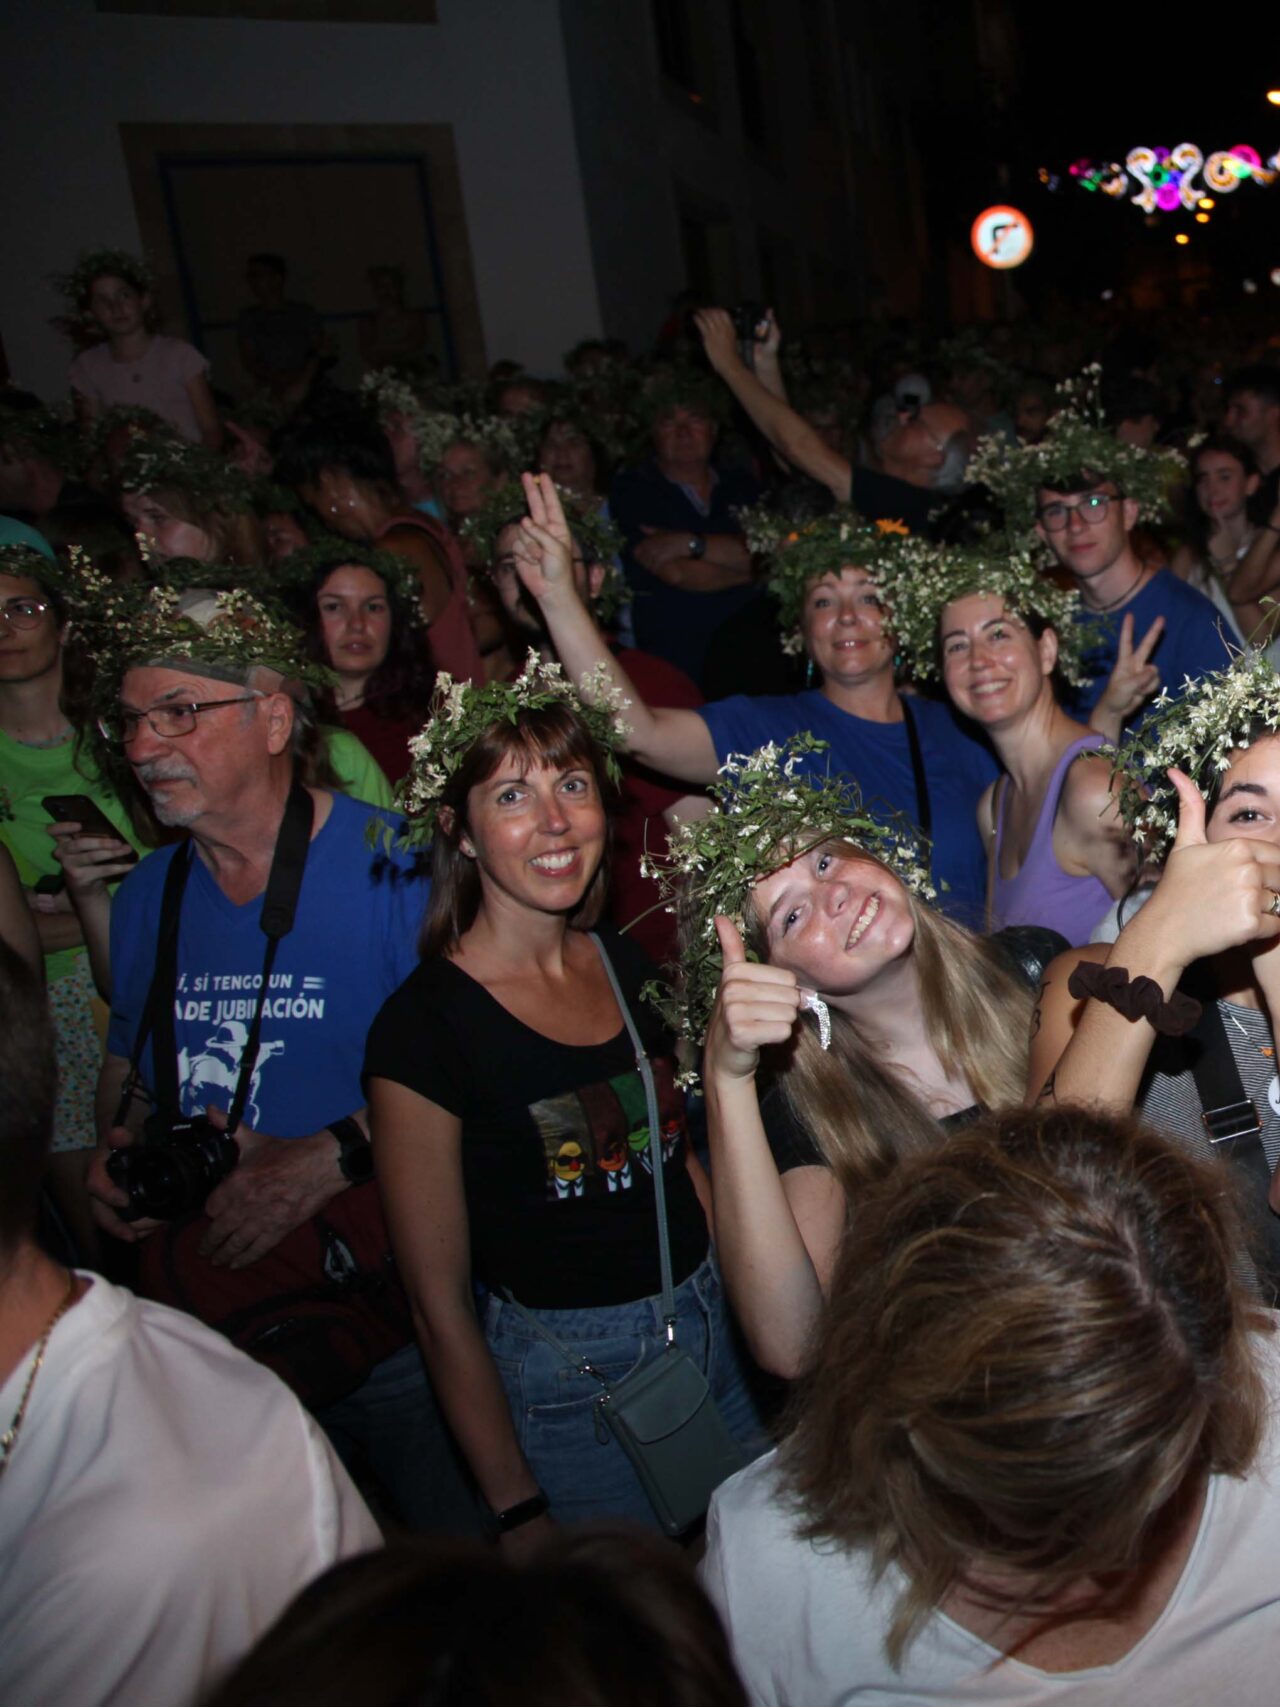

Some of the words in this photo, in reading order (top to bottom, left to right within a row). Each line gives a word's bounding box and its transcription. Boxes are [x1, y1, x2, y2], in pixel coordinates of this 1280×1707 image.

[193, 972, 210, 992] SÍ
[213, 974, 263, 991] TENGO
[268, 973, 294, 989] UN
[184, 1000, 213, 1021] DE
